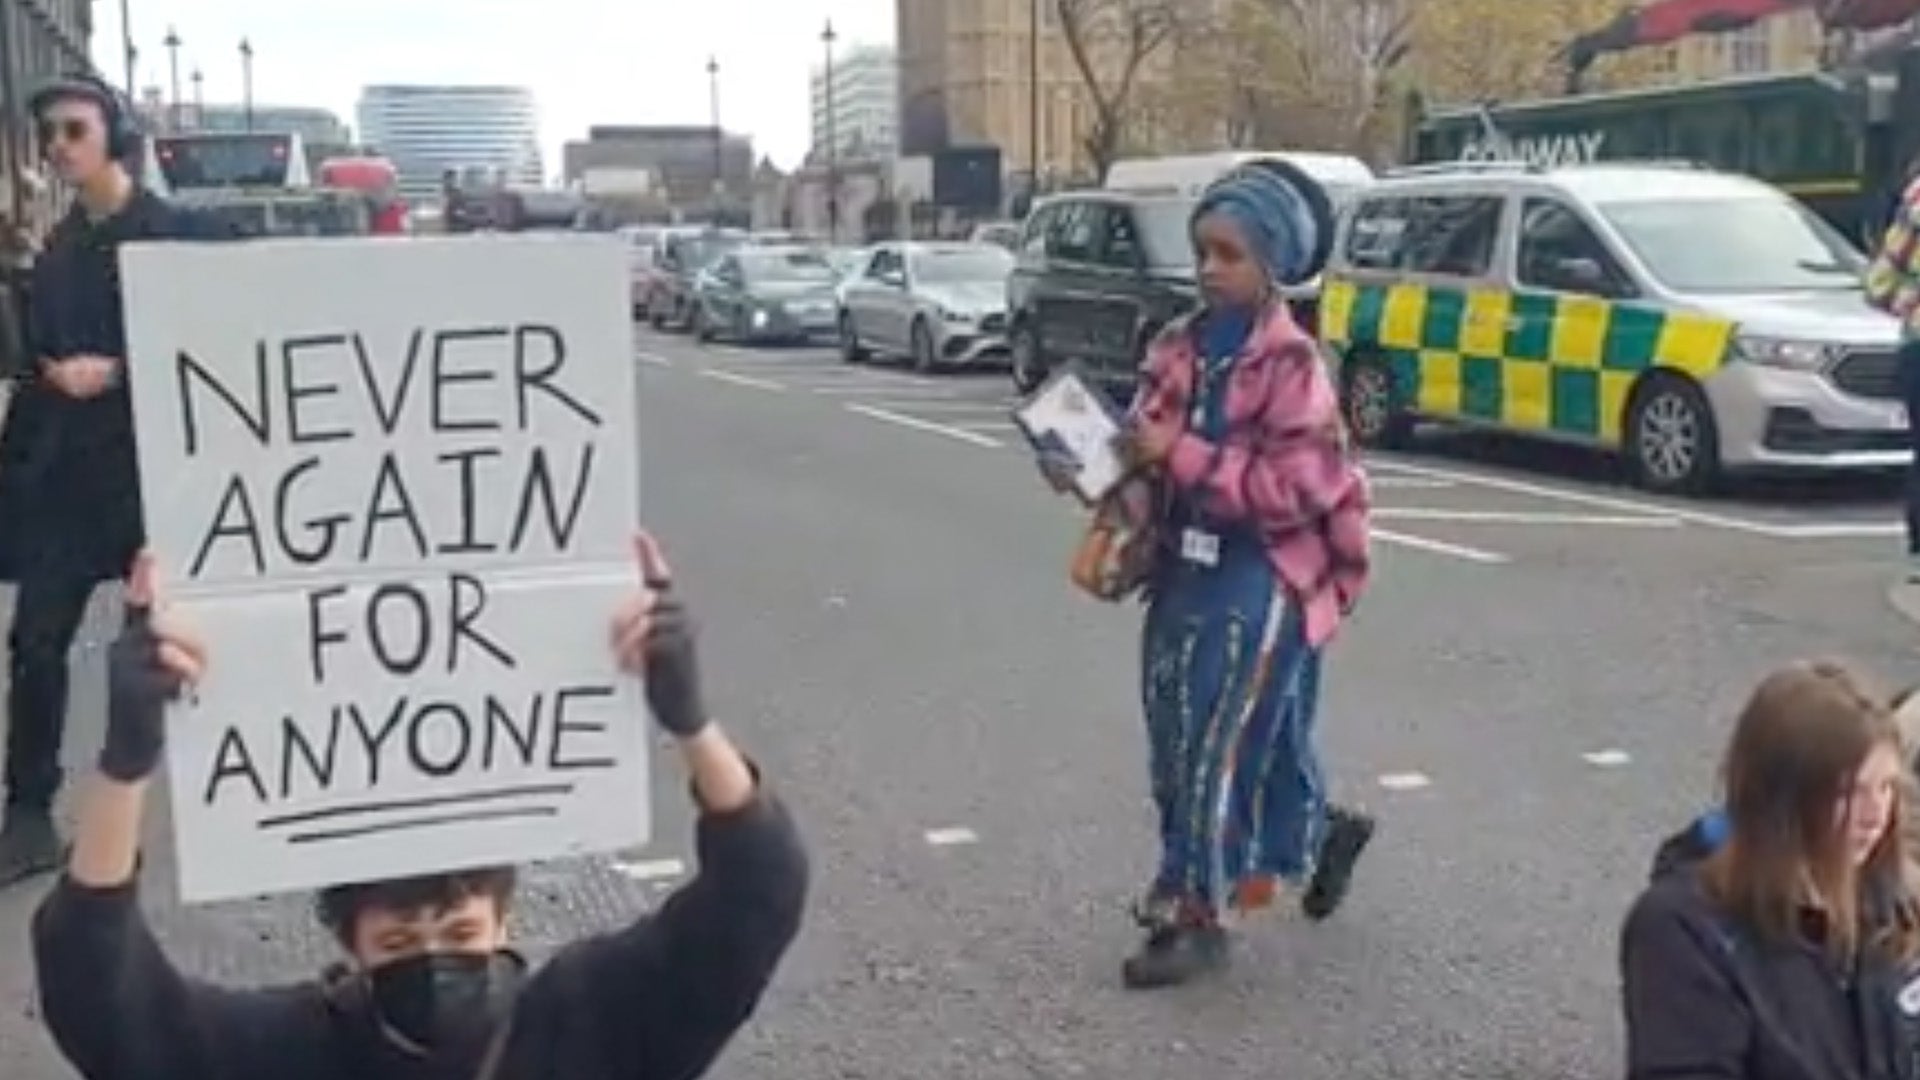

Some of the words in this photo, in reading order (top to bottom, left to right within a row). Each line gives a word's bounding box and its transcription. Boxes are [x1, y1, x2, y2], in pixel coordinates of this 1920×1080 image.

[176, 325, 602, 456] NEVER
[190, 444, 593, 577] AGAIN
[309, 573, 515, 682] FOR
[204, 686, 616, 804] ANYONE
